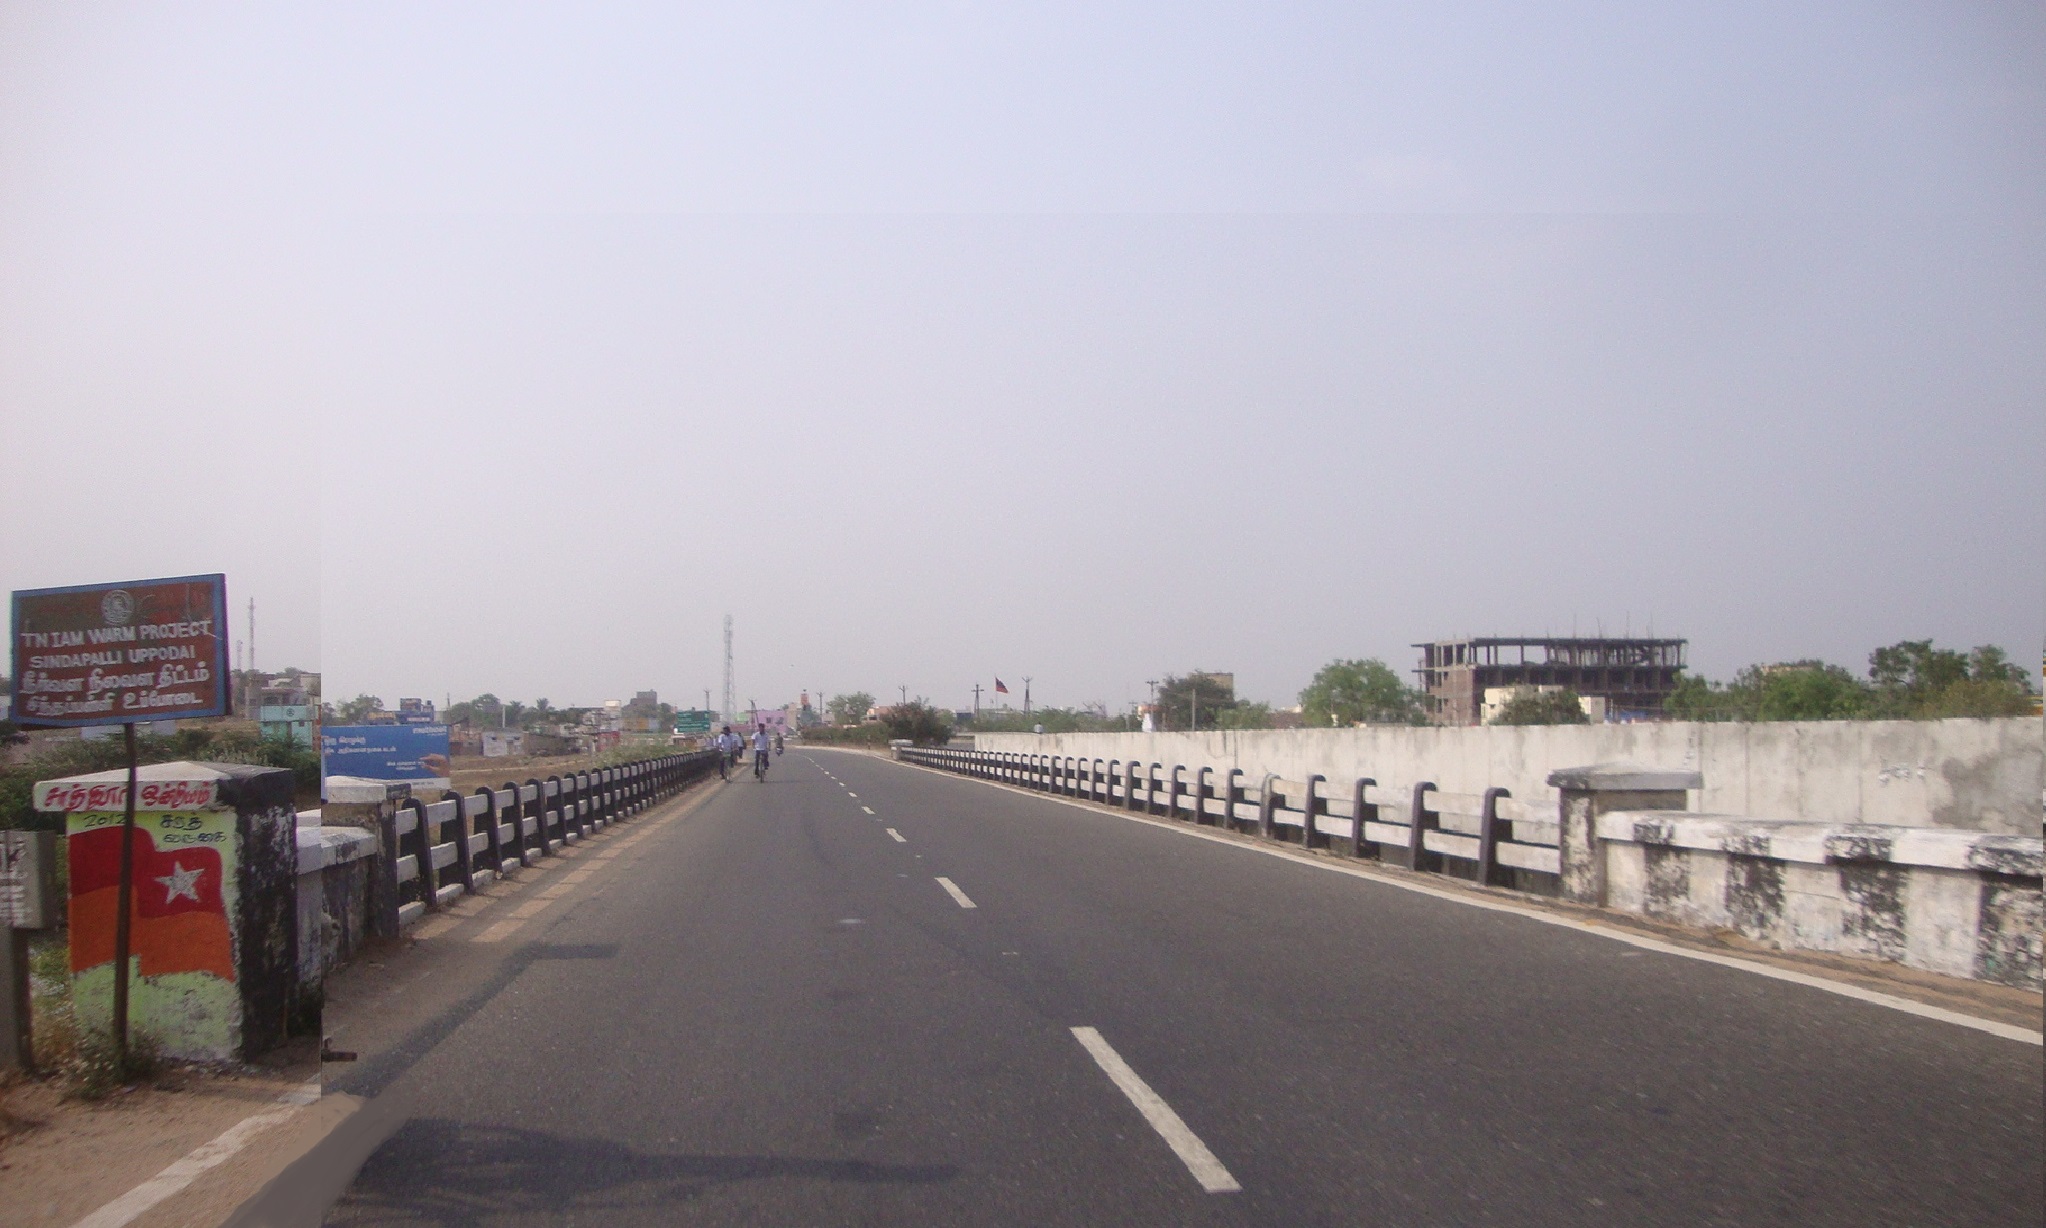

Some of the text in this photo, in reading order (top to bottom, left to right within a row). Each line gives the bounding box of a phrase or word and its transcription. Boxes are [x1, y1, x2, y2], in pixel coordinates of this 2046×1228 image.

[20, 620, 211, 648] TN IAM WARM PROJECT
[29, 645, 196, 669] SINDAPALLI UPPODAI
[156, 661, 210, 689] திட்டம்
